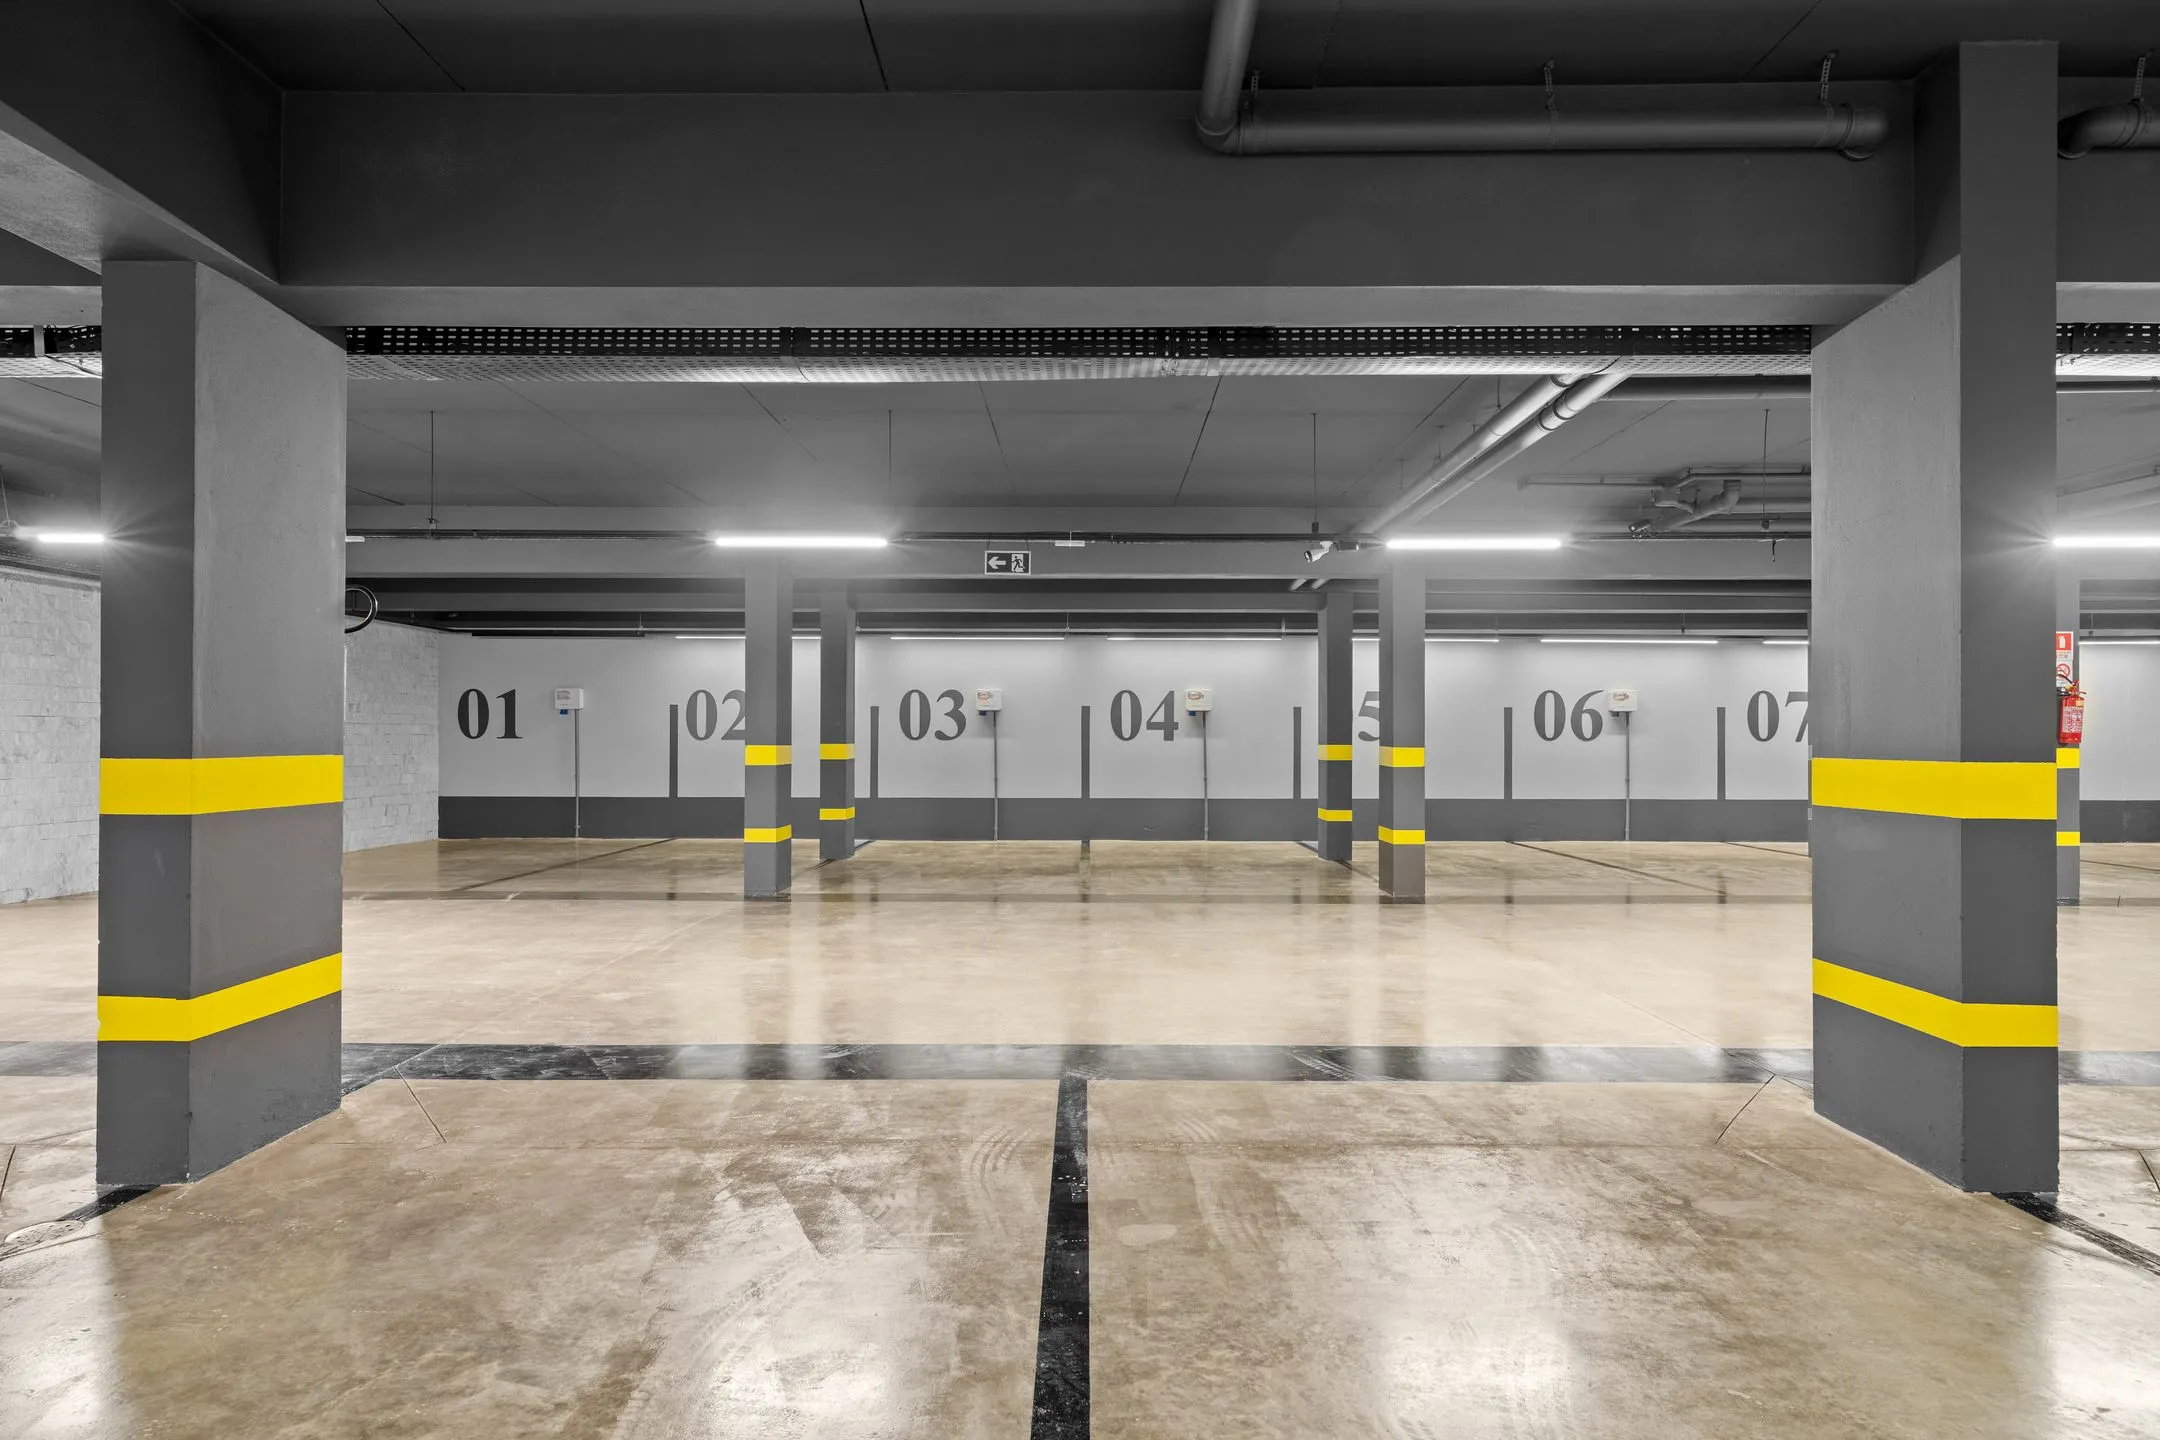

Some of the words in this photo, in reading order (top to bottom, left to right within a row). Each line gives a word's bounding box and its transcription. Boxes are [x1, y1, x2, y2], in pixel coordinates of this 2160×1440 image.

[458, 689, 523, 739] 01
[686, 690, 745, 741] 02
[899, 690, 966, 741] 03
[1111, 690, 1179, 741] 04
[1358, 691, 1379, 742] 5
[1534, 690, 1603, 741] 06
[1747, 690, 1808, 742] 07
